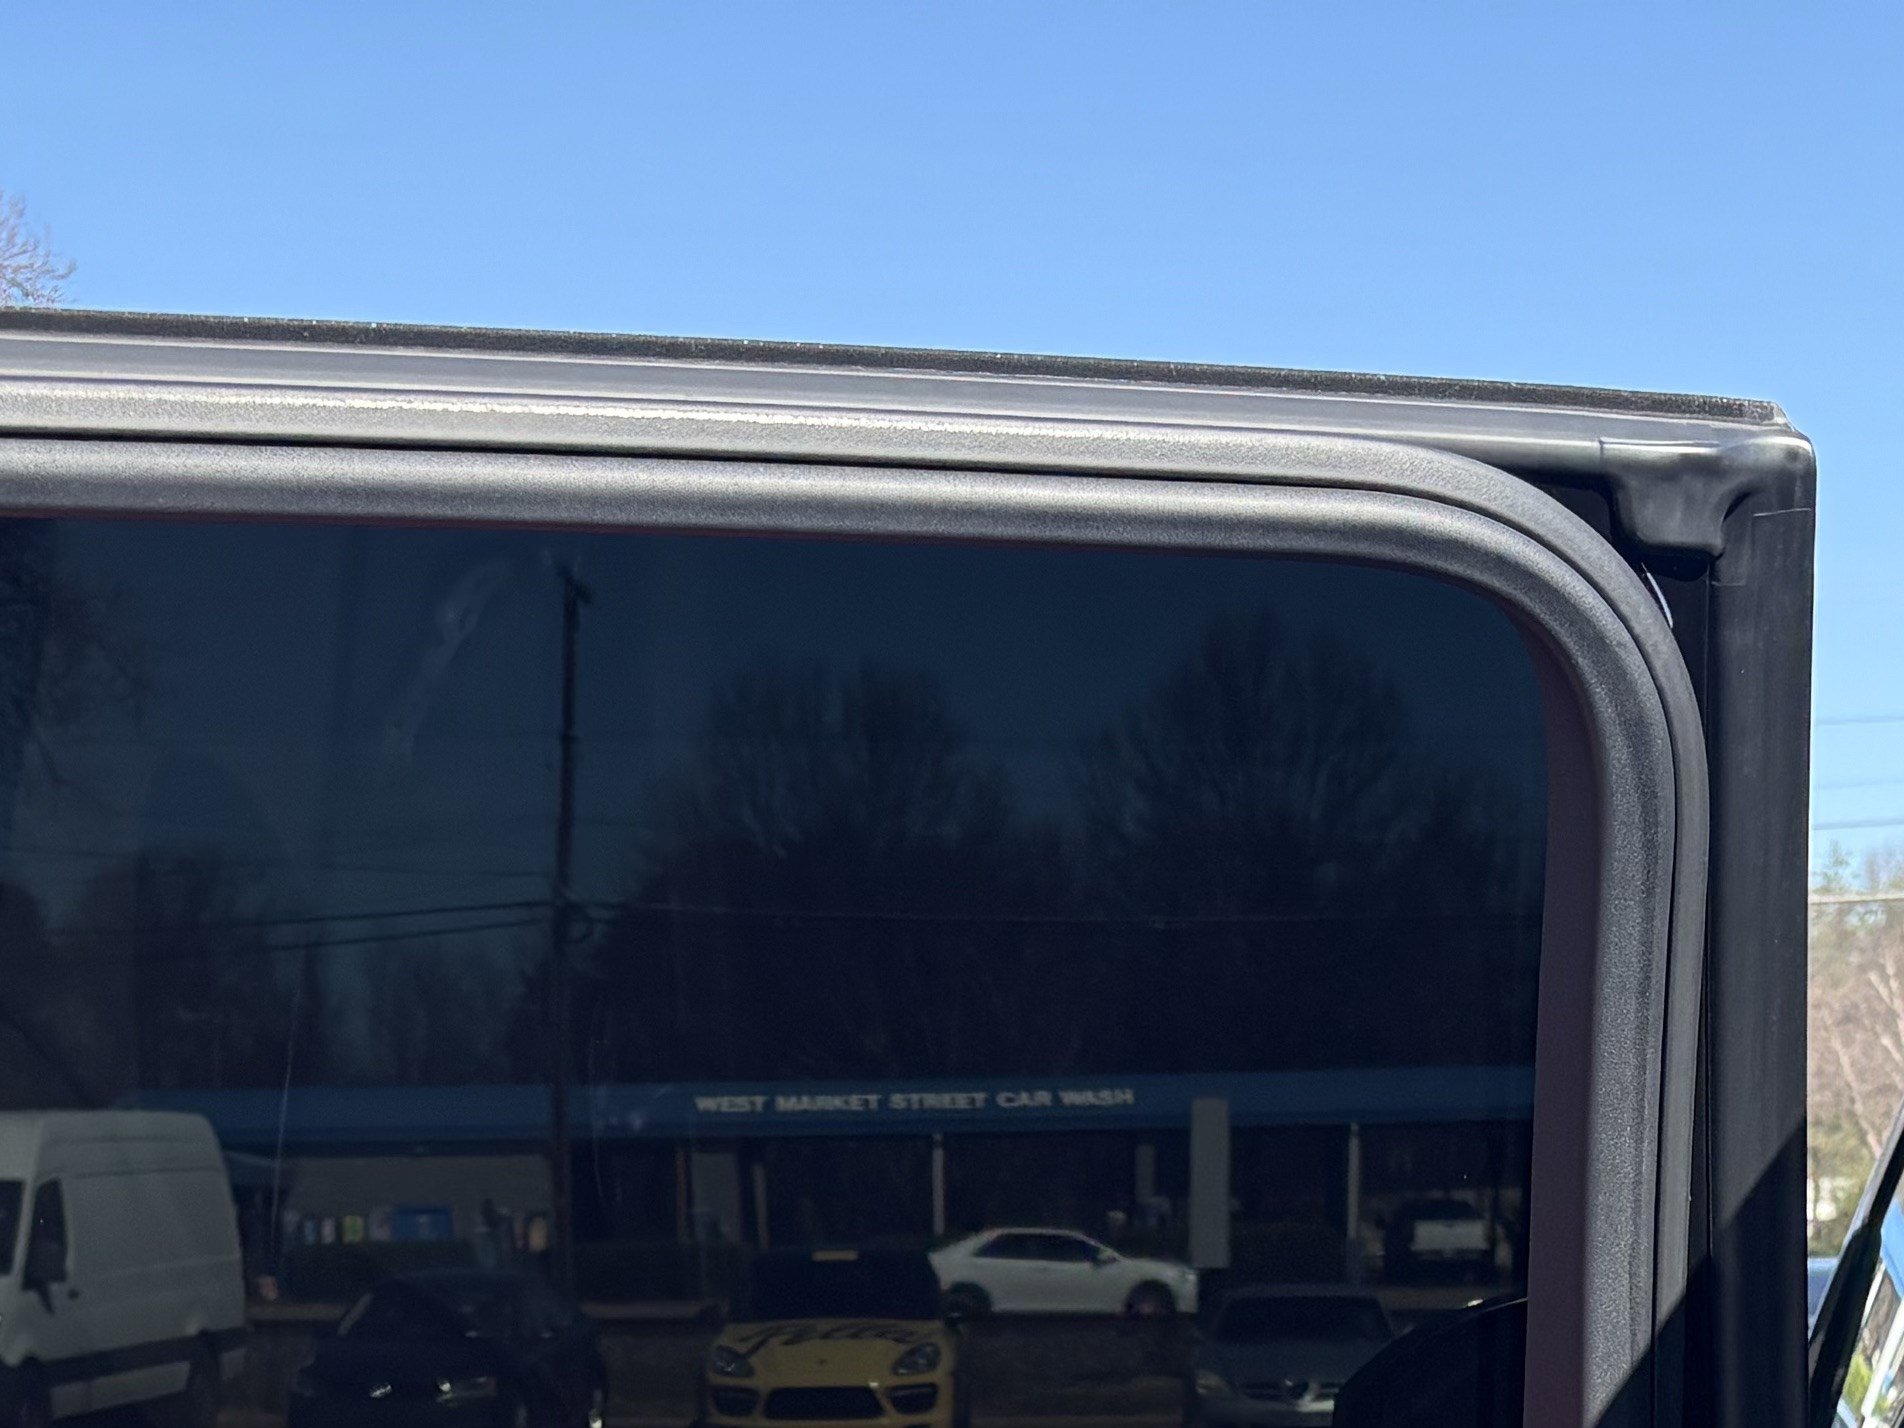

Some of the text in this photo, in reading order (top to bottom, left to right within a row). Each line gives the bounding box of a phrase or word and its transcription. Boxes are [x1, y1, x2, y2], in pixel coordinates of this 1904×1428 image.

[696, 1088, 1135, 1112] WEST MARKET STREET CAR WASH
